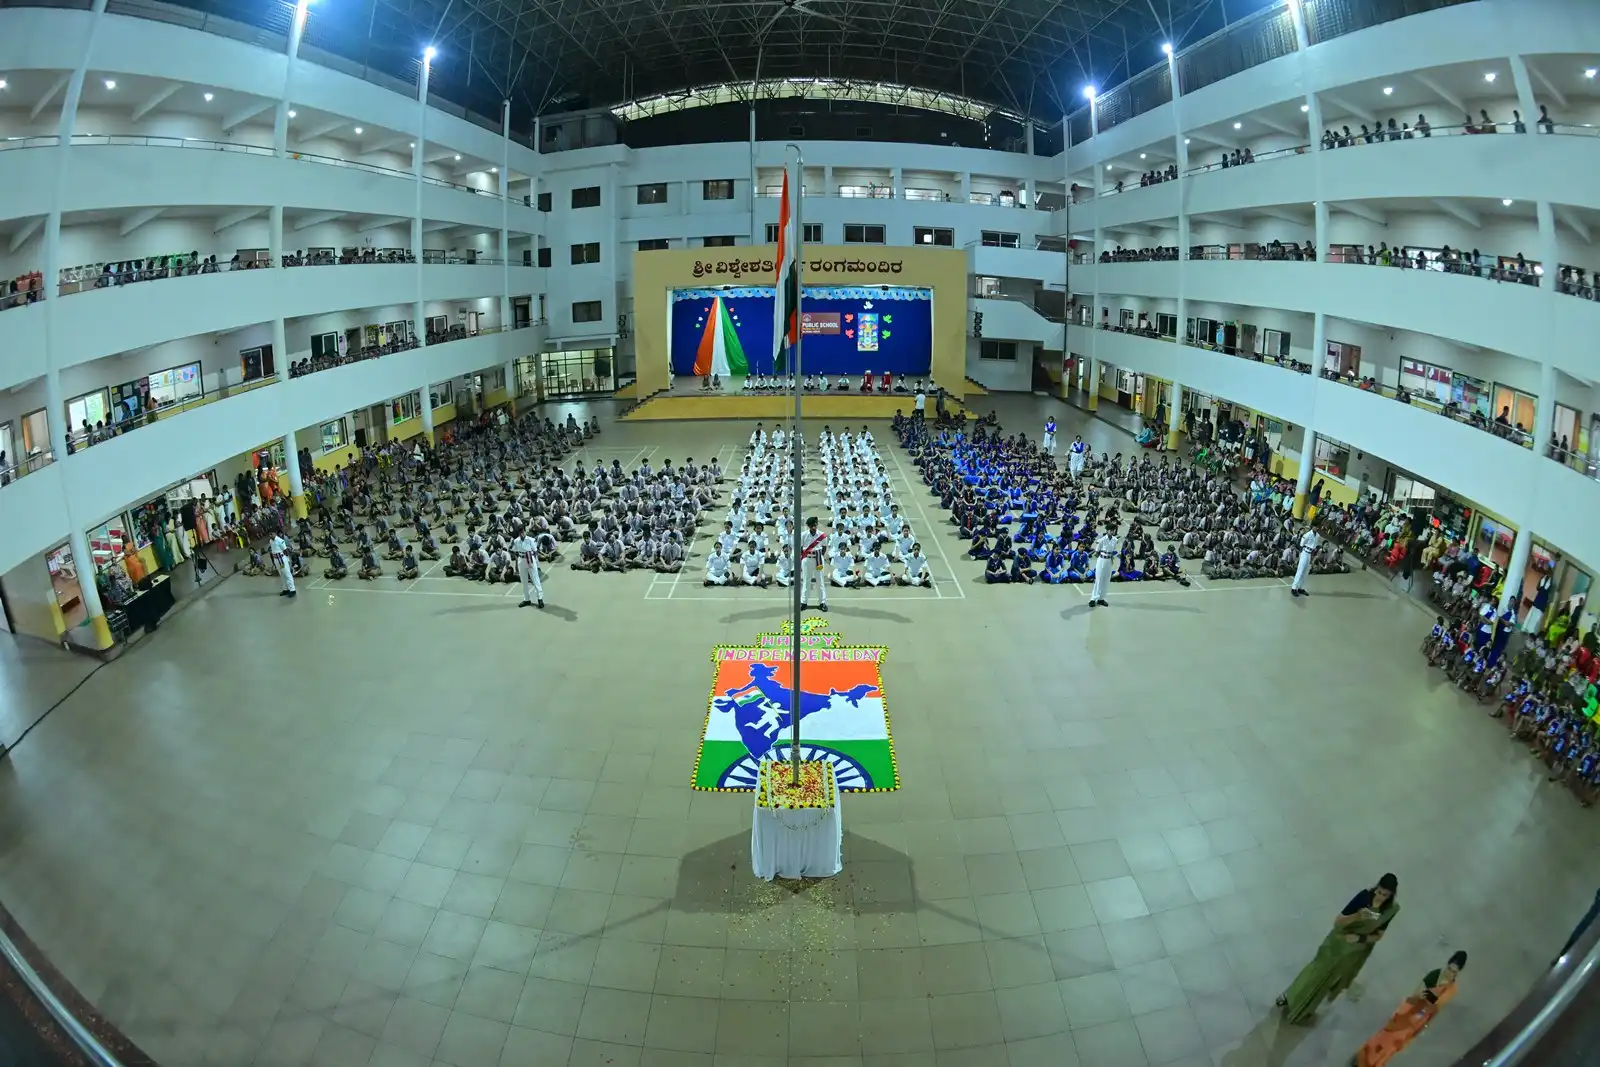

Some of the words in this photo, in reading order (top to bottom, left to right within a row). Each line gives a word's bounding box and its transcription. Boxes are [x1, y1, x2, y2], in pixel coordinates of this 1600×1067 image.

[692, 260, 713, 278] ಶ್ರೀ
[810, 258, 903, 273] ರಂಗಮಂದಿರ
[853, 648, 881, 661] DAY
